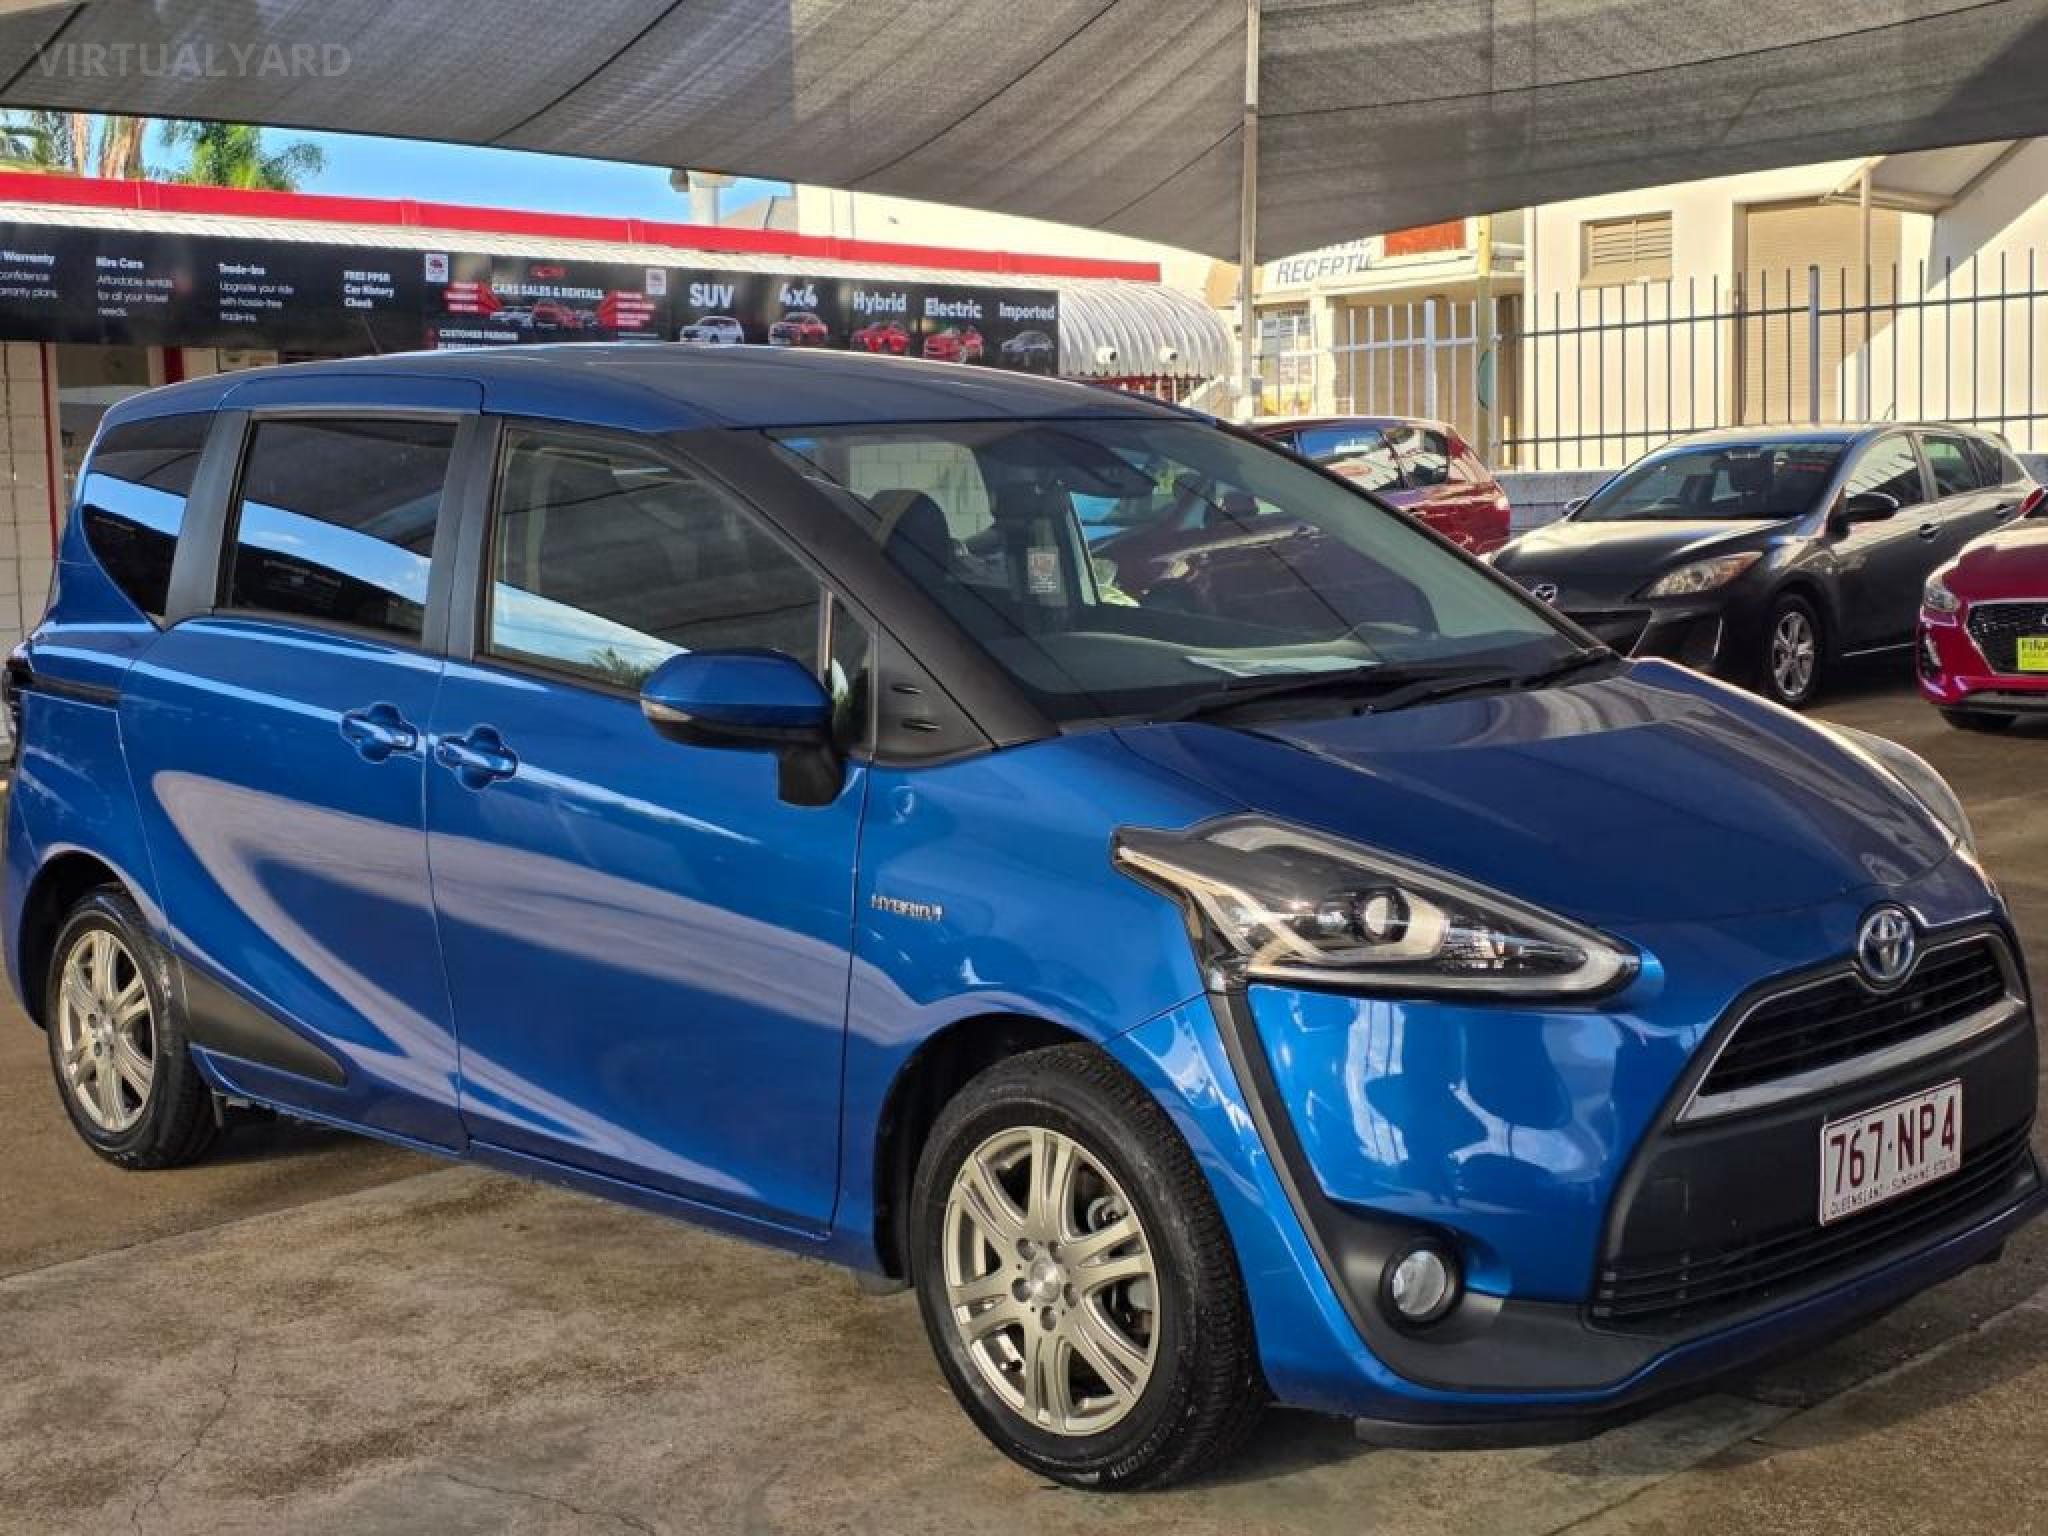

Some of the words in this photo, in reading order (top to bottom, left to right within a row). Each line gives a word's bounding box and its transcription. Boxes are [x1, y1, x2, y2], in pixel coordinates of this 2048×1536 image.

[119, 257, 144, 269] Cars
[689, 283, 735, 309] SUV
[779, 283, 818, 307] 4x4
[853, 290, 907, 315] Hybrid
[924, 297, 982, 320] Electric
[999, 301, 1055, 322] Imported
